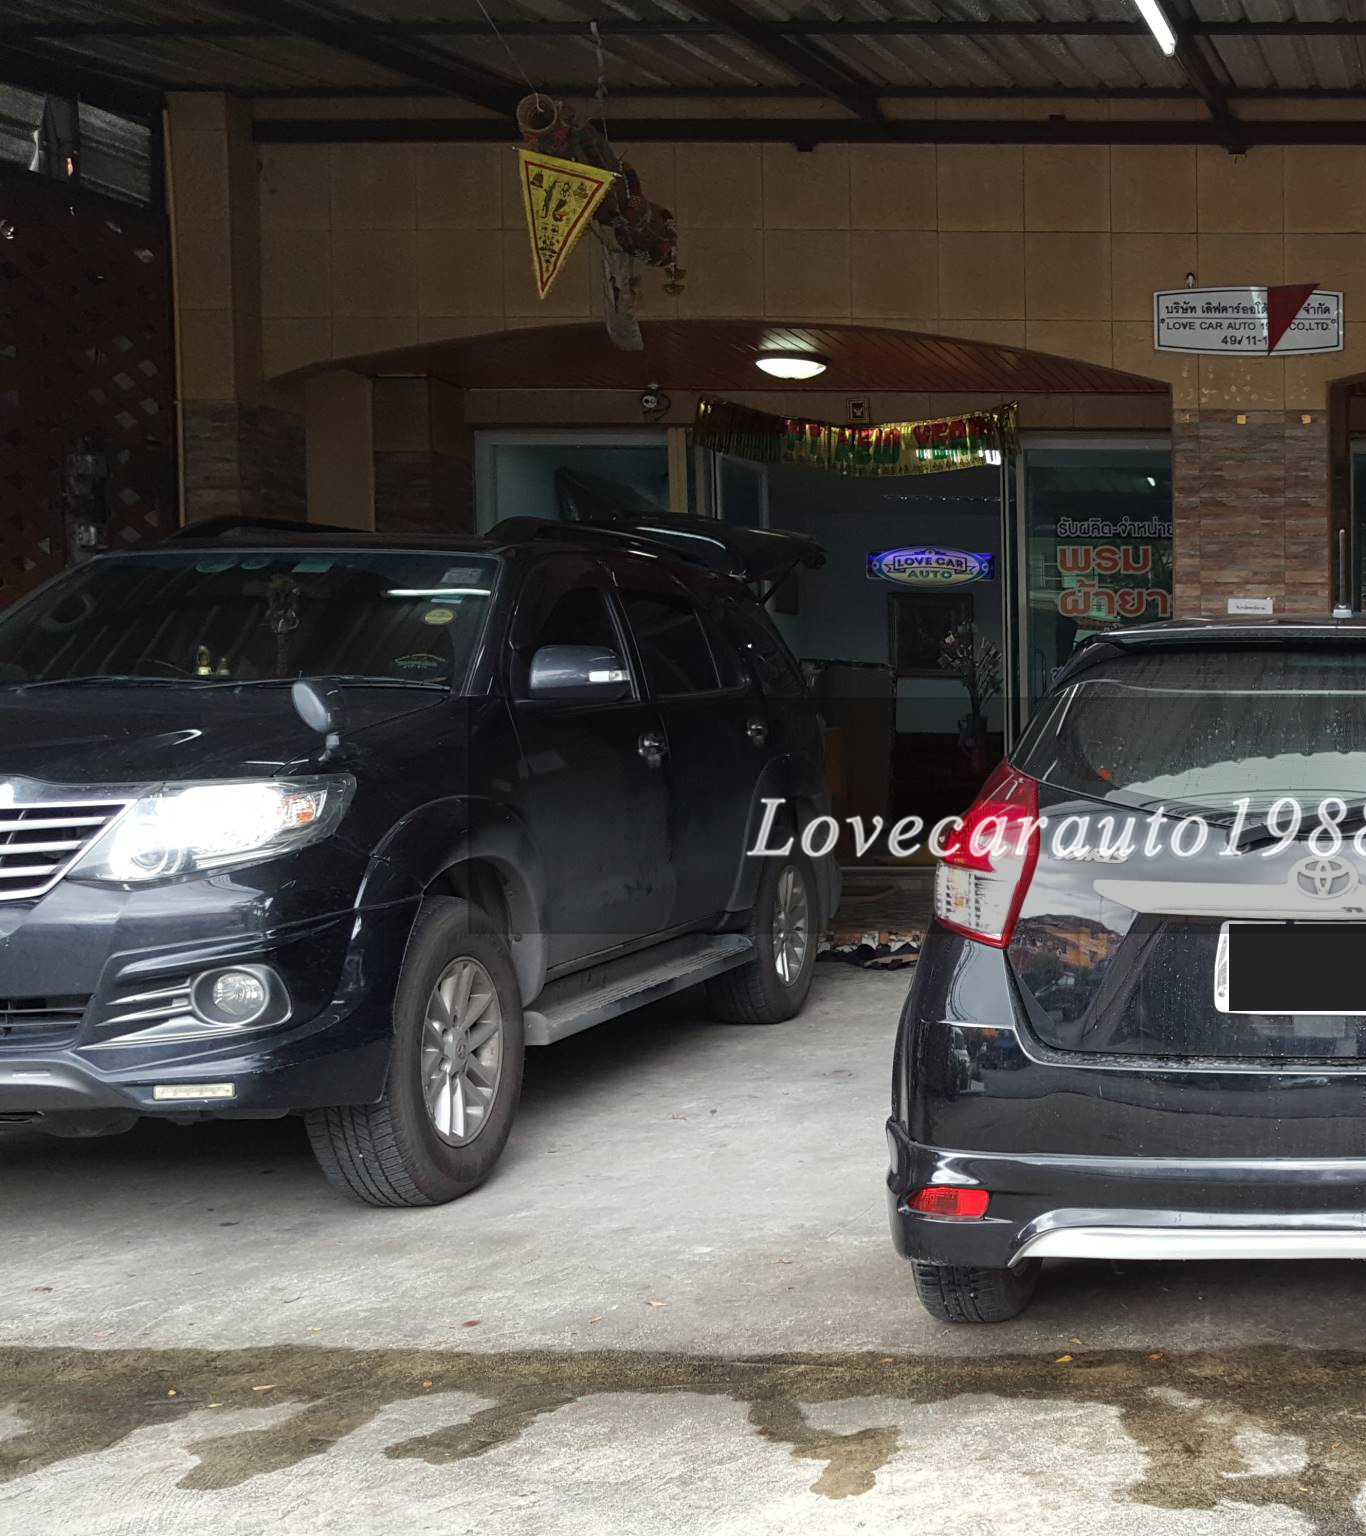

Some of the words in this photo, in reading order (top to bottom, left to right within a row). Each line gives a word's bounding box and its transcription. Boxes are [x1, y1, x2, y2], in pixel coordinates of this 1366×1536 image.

[1165, 301, 1197, 315] บริษัท
[1302, 302, 1331, 315] จำกัด
[1166, 321, 1196, 331] LOVE
[1200, 321, 1223, 331] CAR
[1226, 321, 1257, 331] AUTO
[897, 556, 932, 568] LOVE
[935, 556, 964, 568] CAR
[1057, 545, 1151, 575] พรม
[907, 569, 953, 580] AUTO
[1058, 579, 1173, 618] ผ้ายา
